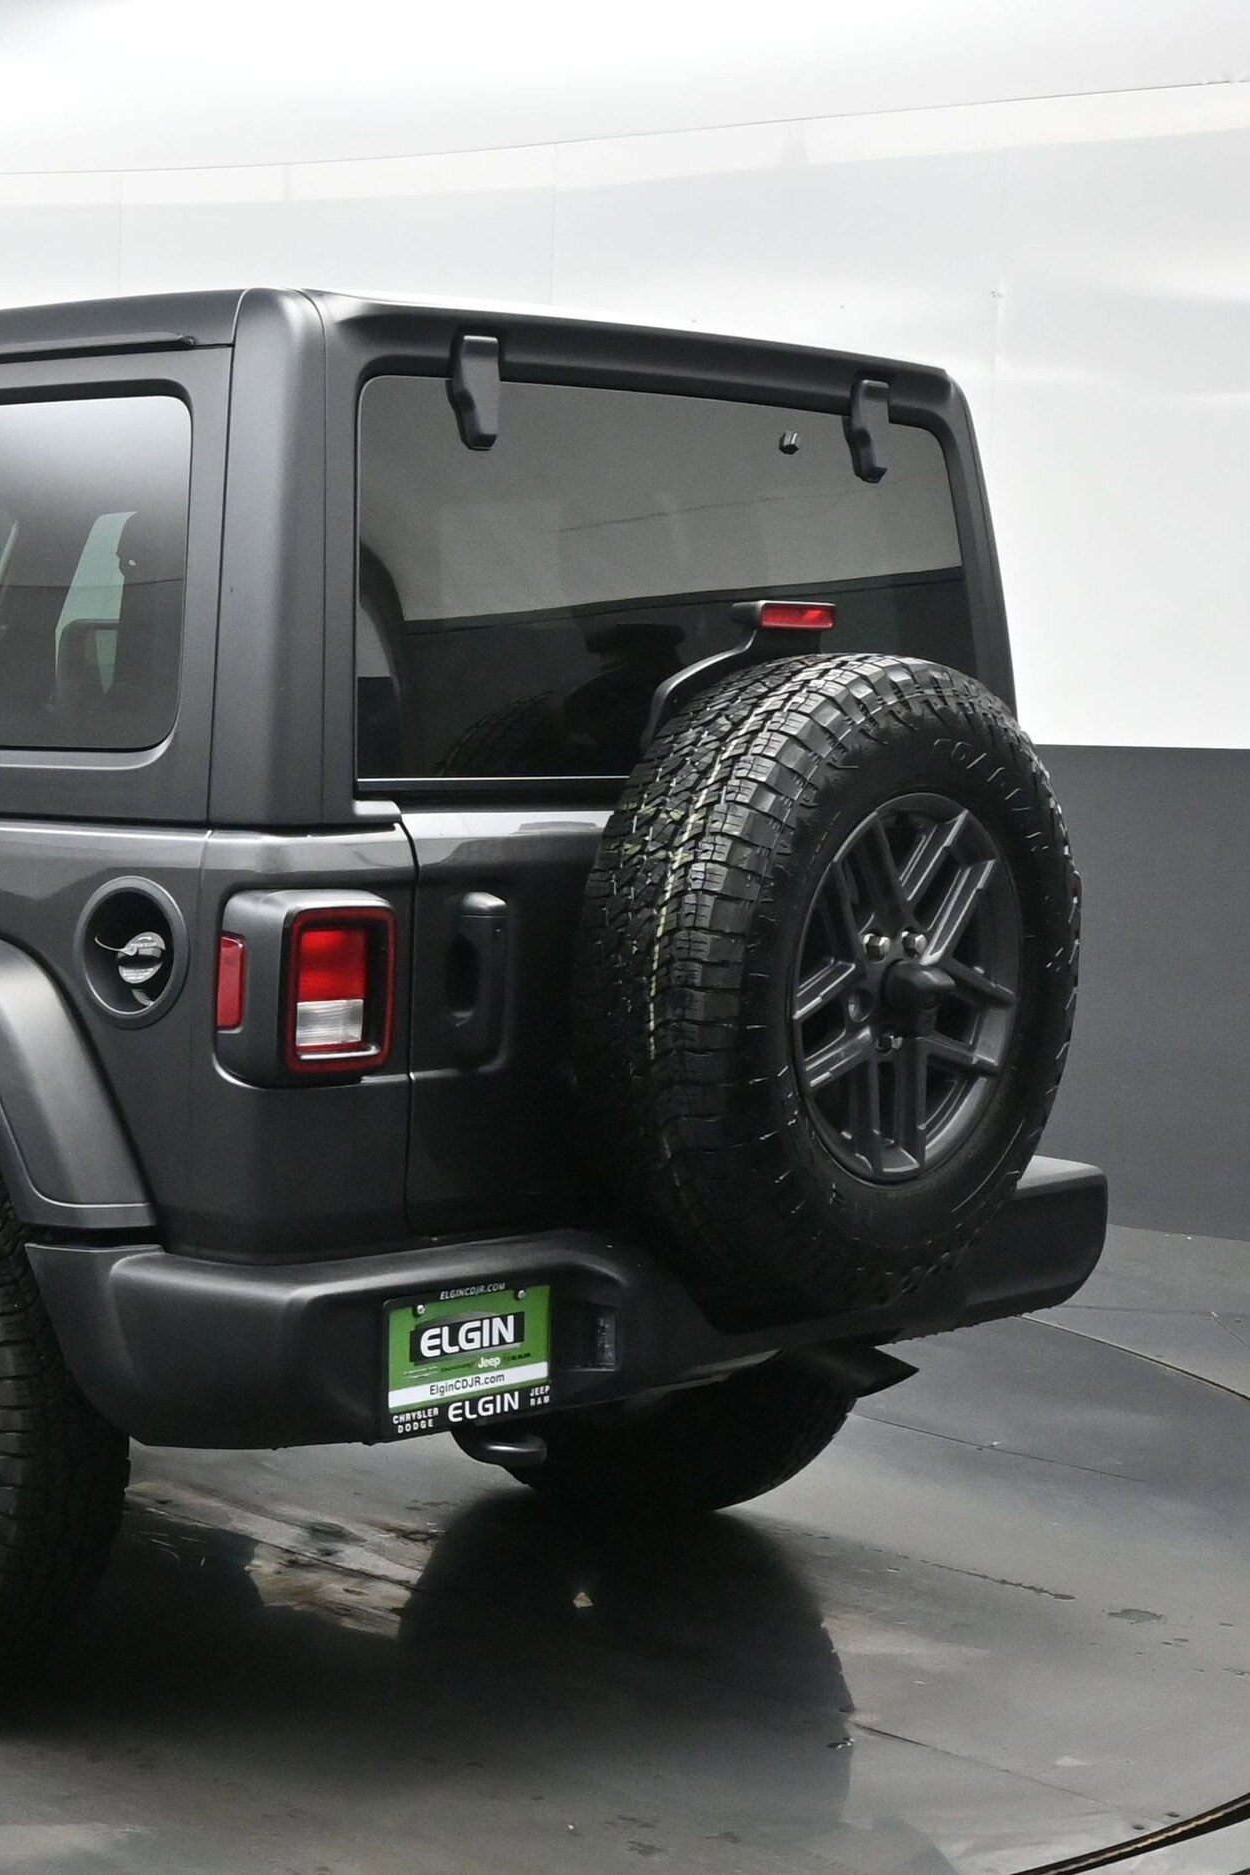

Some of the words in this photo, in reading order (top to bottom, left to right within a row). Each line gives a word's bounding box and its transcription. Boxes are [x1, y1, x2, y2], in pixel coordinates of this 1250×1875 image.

[439, 1283, 506, 1301] ELGINCDJR.COM
[419, 1315, 515, 1358] ELGIN
[477, 1356, 501, 1369] Jeep
[429, 1374, 506, 1396] ElginCDJR.com
[529, 1385, 551, 1398] JEEP
[447, 1391, 520, 1423] ELGIN
[530, 1396, 551, 1407] RAM
[392, 1407, 440, 1425] CHRYSLER
[397, 1419, 434, 1434] DODGE
